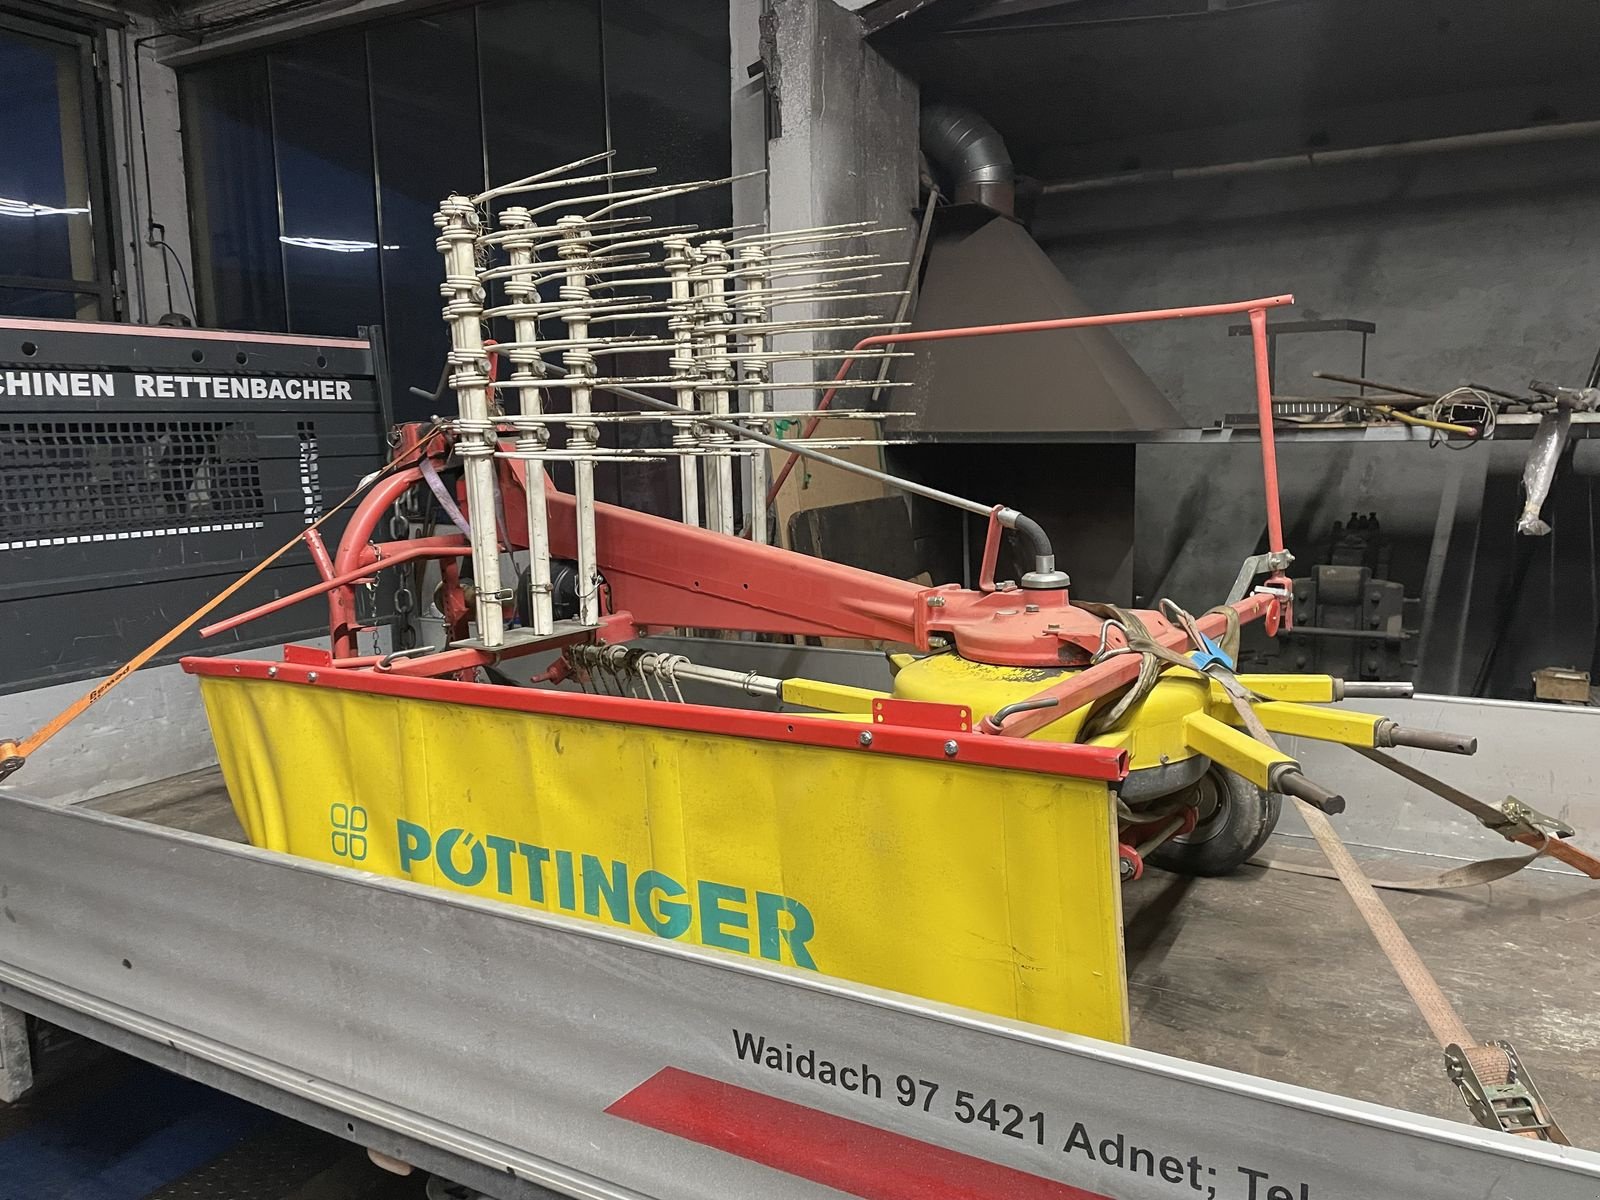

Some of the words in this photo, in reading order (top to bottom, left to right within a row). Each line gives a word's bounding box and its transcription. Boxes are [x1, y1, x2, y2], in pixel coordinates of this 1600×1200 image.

[0, 372, 114, 396] HINEN
[136, 375, 351, 399] RETTENBACHER
[396, 819, 819, 971] PÖTTINGER
[732, 1029, 882, 1098] Waidach
[896, 1074, 939, 1112] 97
[954, 1092, 1045, 1145] 5421
[1063, 1122, 1216, 1200] Adnet;
